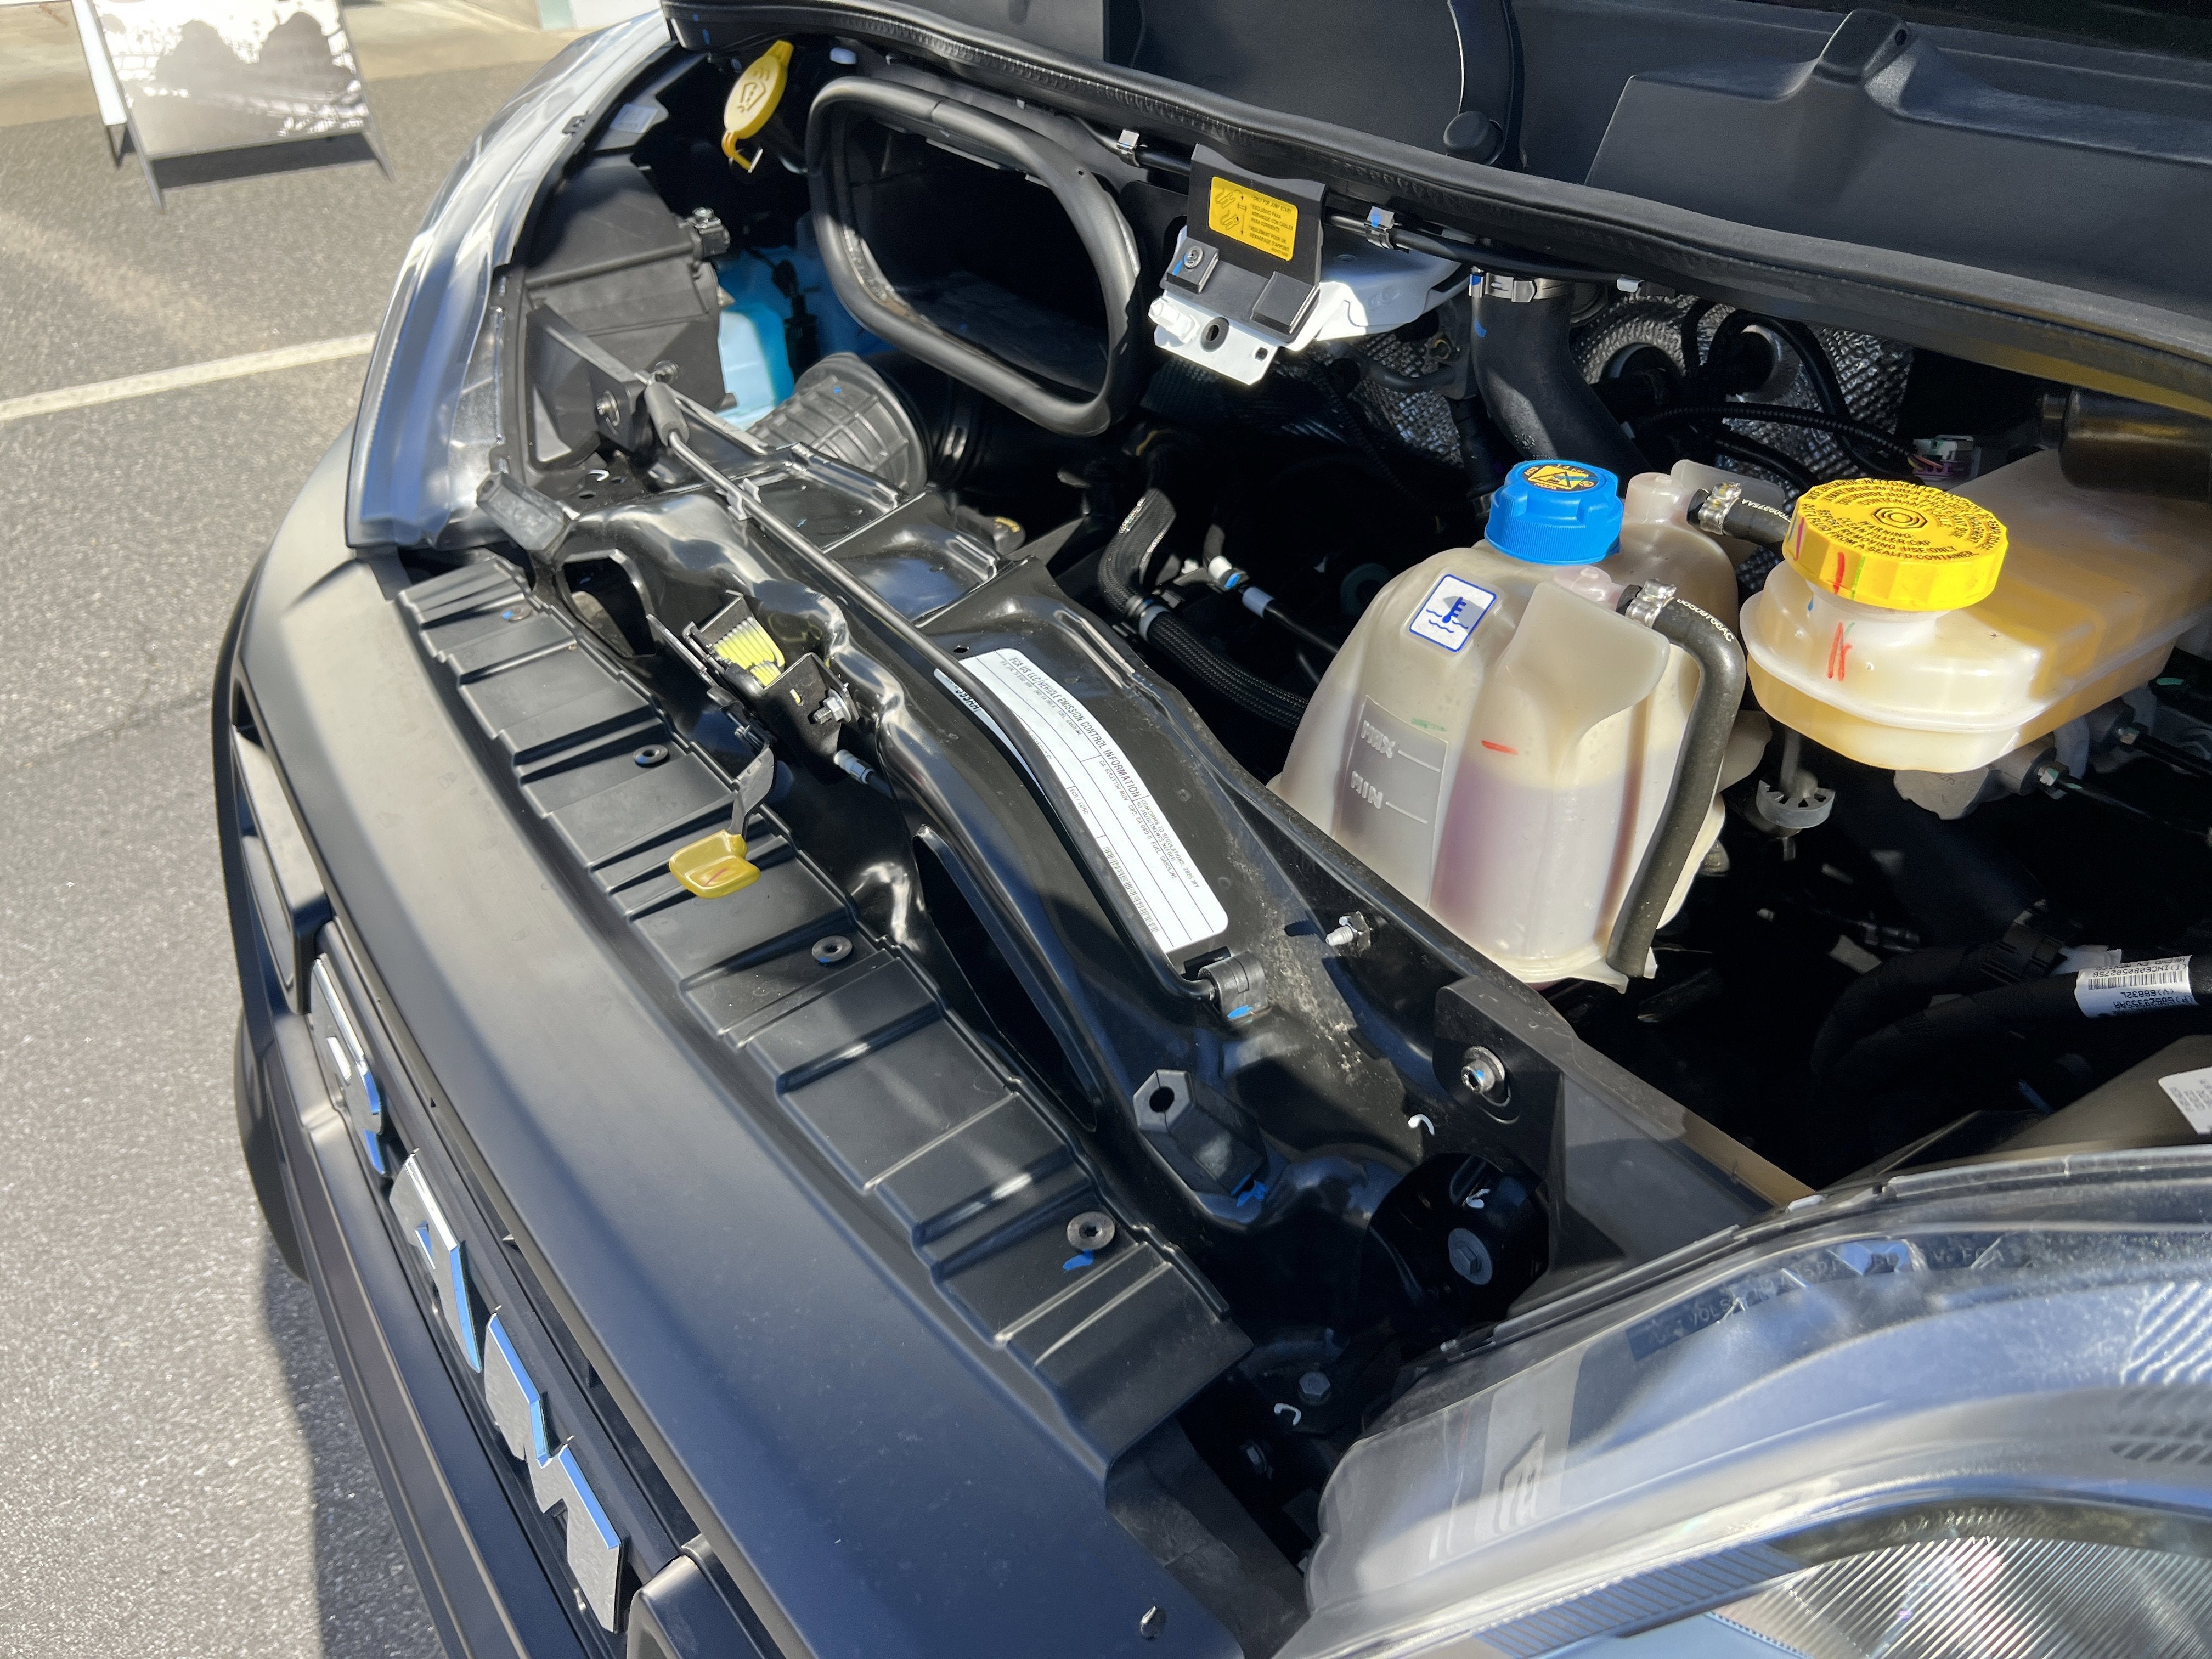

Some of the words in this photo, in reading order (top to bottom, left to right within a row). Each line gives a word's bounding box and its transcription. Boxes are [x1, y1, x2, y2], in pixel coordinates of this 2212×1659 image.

[1867, 532, 1905, 544] FILLER
[1868, 546, 1912, 558] SEALED
[1009, 657, 1024, 667] FCA
[1037, 681, 1062, 699] VEHICLE
[1057, 698, 1086, 721] EMISSION
[1080, 721, 1107, 749] CONTROL
[1103, 749, 1142, 798] INFORMATION
[1361, 719, 1397, 759] MAX
[1070, 789, 1079, 798] EGR
[1078, 802, 1089, 815] EGRC
[1350, 770, 1384, 810] MIN
[1141, 809, 1164, 842] ADJUSTMENTS
[1161, 843, 1175, 861] NEEDED
[1141, 800, 1160, 825] CONFORMS
[1191, 879, 1200, 888] MY
[1160, 856, 1177, 879] GASOLINE
